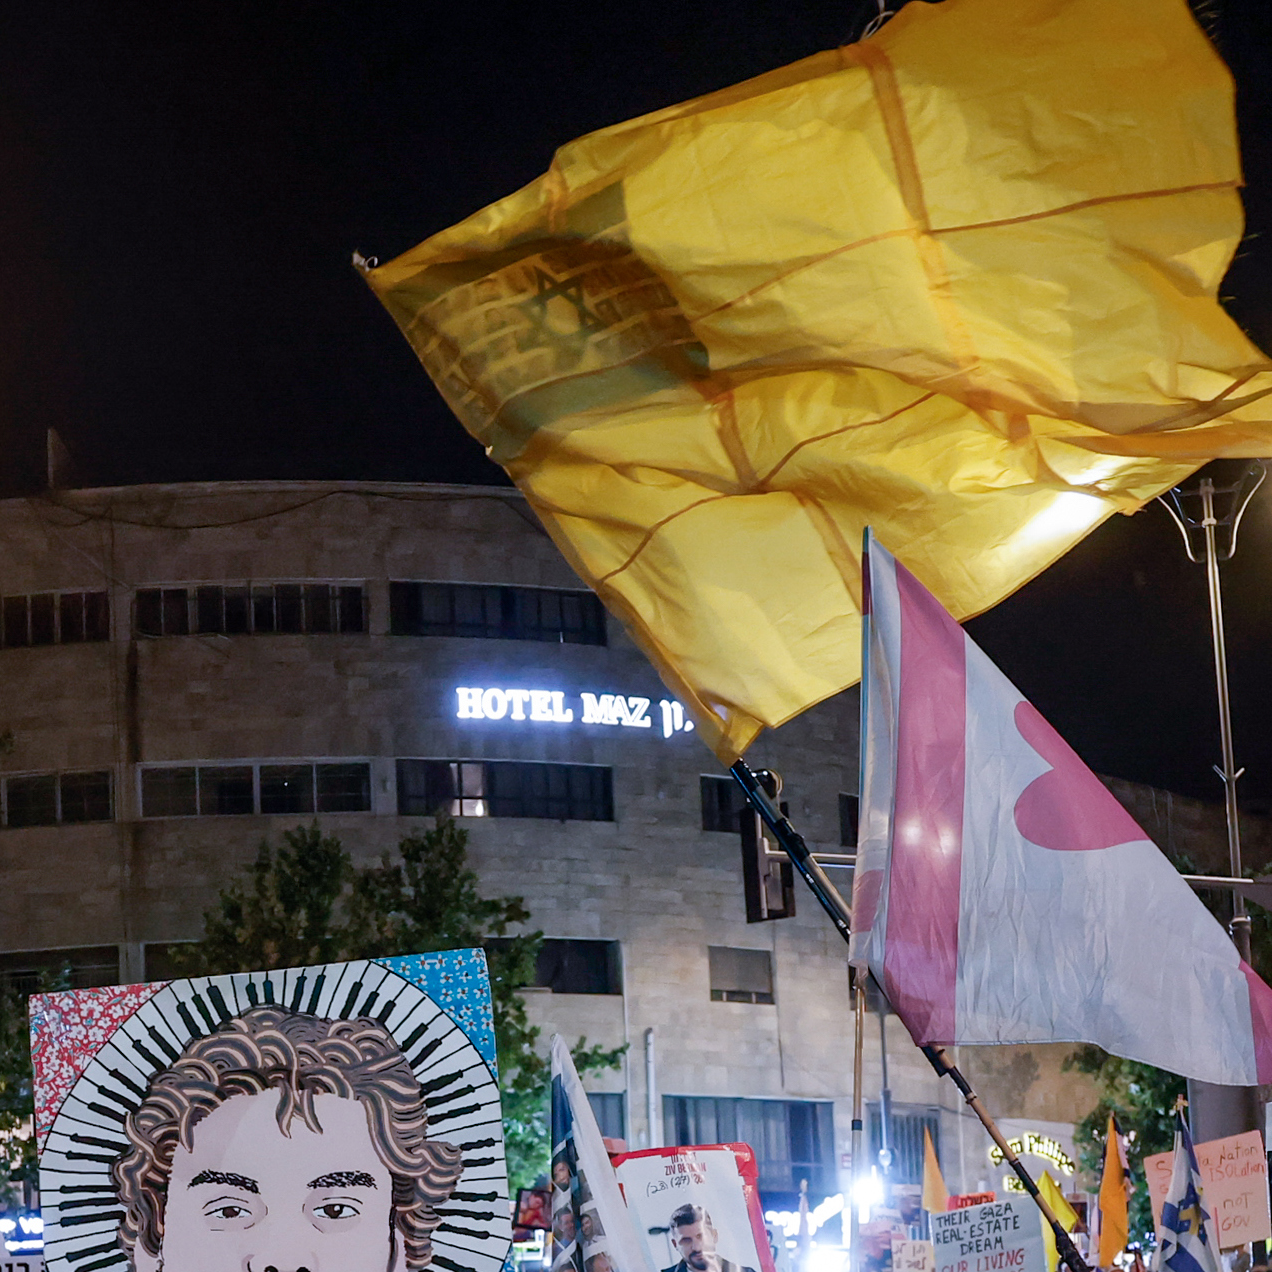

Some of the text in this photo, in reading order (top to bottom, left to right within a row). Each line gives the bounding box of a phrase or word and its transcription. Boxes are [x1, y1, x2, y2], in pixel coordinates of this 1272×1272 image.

[456, 687, 651, 728] HOTEL MAZ
[988, 1137, 1023, 1168] Sm
[664, 1165, 676, 1176] ZIV
[936, 1202, 1014, 1229] THEIR GAZA
[936, 1216, 1020, 1245] REAL-ESTATE
[960, 1236, 1004, 1257] DREAM
[977, 1248, 1025, 1272] LIVING
